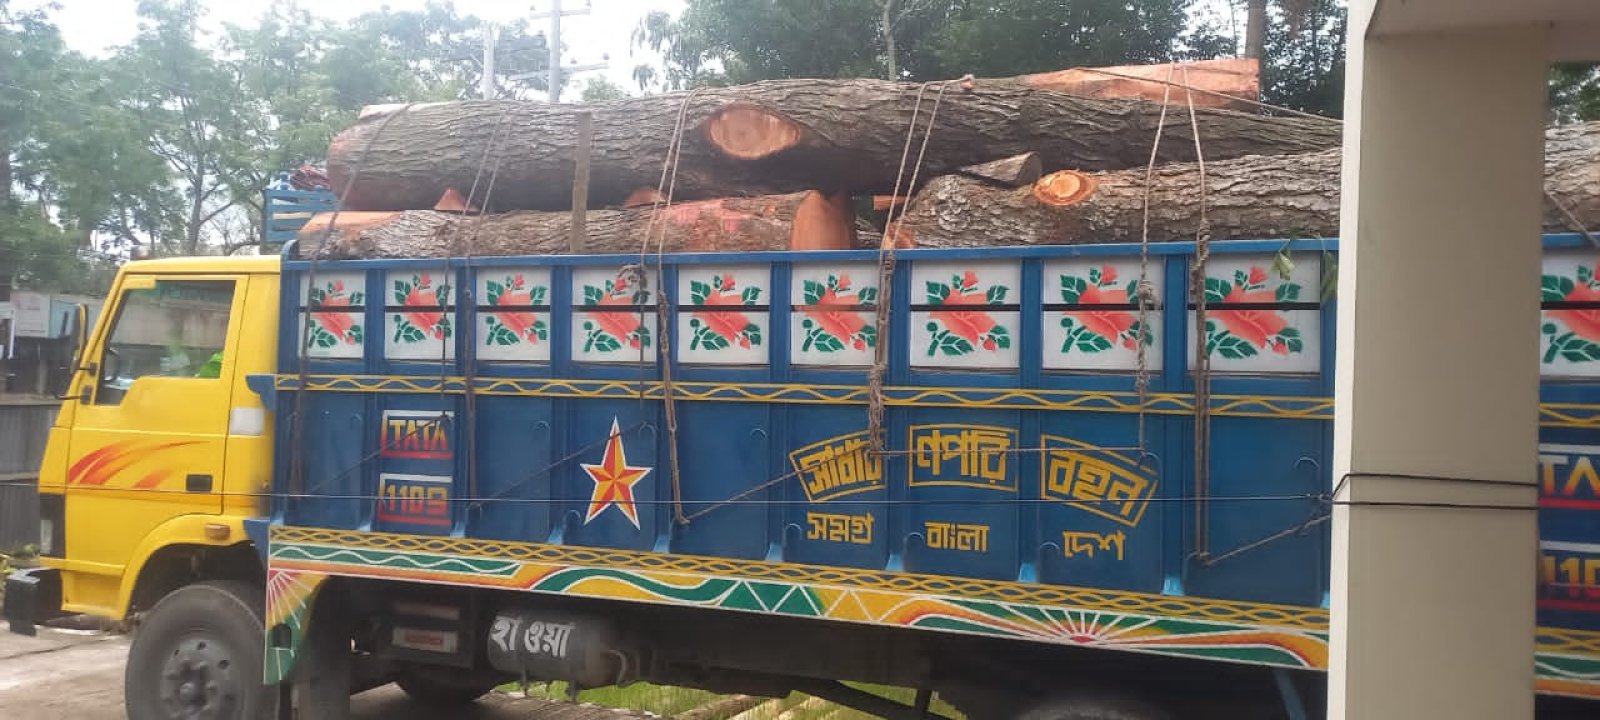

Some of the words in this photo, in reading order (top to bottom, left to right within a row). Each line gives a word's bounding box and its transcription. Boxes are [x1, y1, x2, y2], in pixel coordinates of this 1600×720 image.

[388, 419, 449, 450] TATA
[1048, 448, 1149, 516] বহন
[807, 511, 875, 545] সমগ্র
[924, 521, 990, 552] বাংলা
[1062, 530, 1126, 561] দেশ
